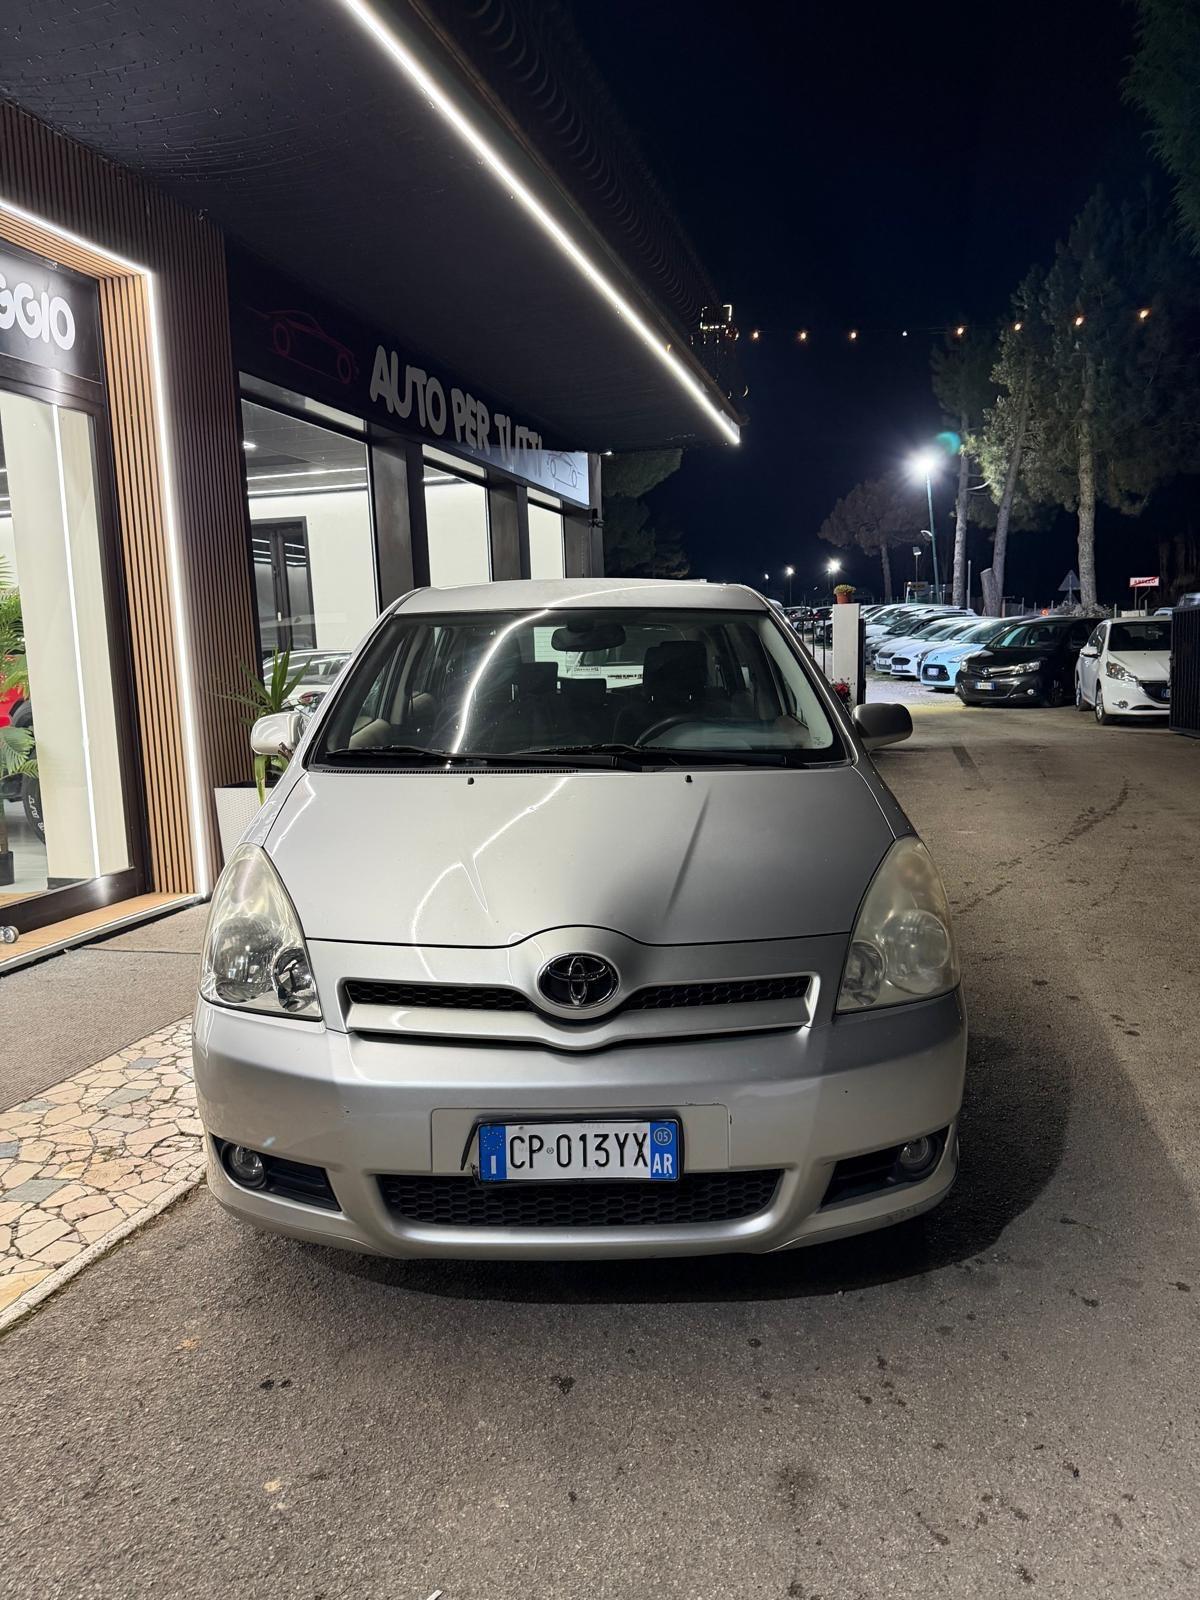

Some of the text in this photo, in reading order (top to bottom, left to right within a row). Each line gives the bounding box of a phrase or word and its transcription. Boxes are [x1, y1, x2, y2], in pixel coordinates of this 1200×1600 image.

[370, 345, 447, 435] AUTO
[451, 388, 490, 456] PER
[509, 1133, 649, 1169] CP 013YX
[652, 1153, 673, 1174] AR
